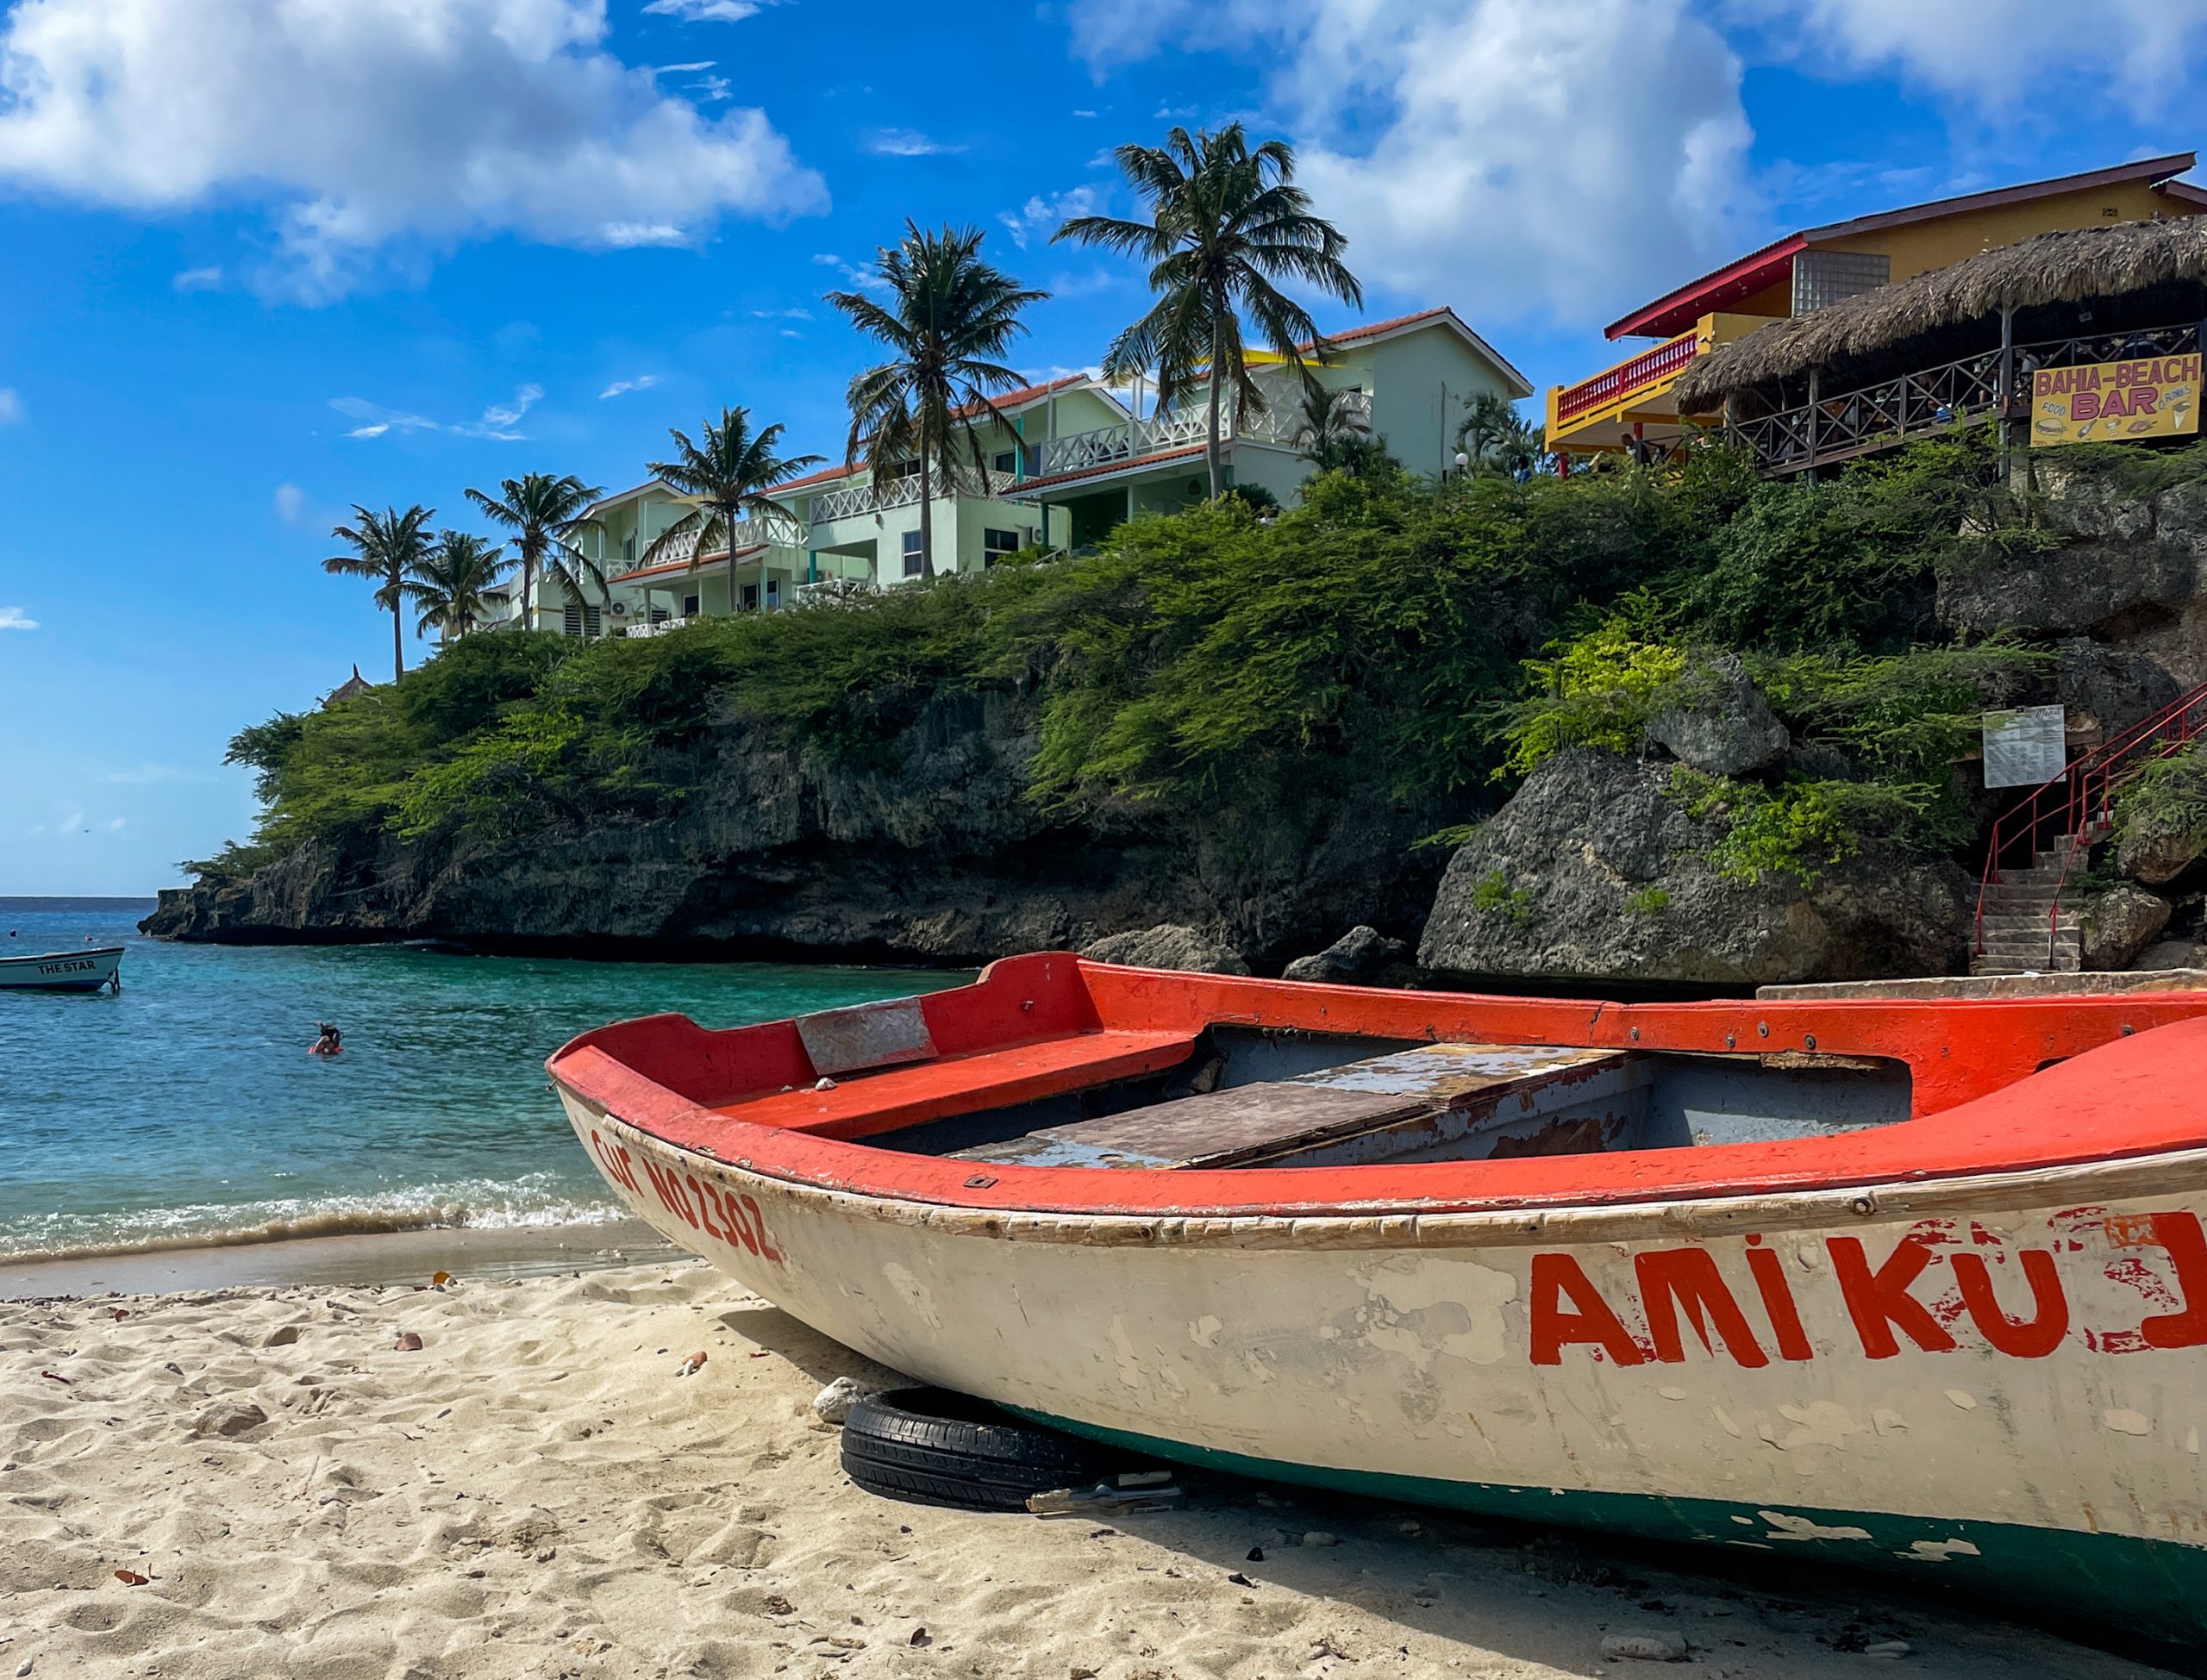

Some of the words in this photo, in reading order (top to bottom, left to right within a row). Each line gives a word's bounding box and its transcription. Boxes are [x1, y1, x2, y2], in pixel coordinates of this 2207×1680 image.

[2035, 356, 2199, 397] BAHIA-BEACH
[2041, 401, 2066, 416] FOOD
[2071, 386, 2158, 422] BAR
[2158, 384, 2192, 410] DRINKS
[37, 964, 62, 975] THE
[64, 960, 96, 972] STAR
